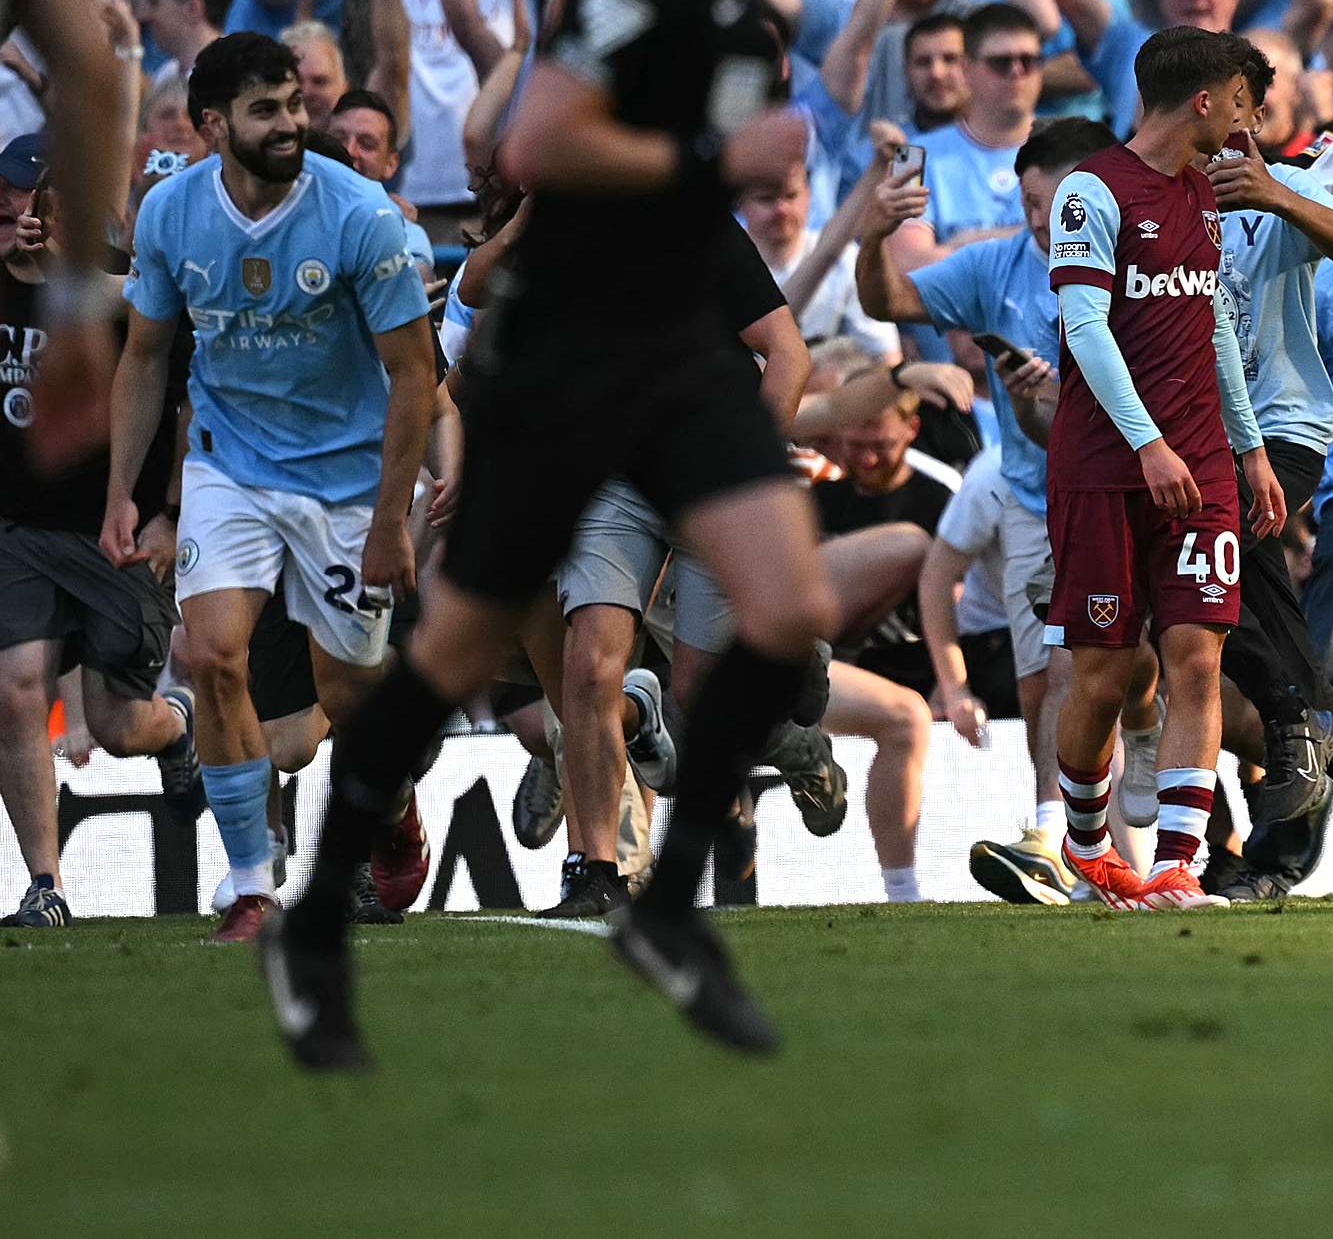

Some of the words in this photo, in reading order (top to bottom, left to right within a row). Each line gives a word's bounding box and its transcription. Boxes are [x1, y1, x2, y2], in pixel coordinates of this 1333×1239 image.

[1064, 243, 1086, 252] room
[1064, 250, 1090, 258] racism
[1125, 264, 1218, 305] betwa
[1177, 530, 1241, 586] 40
[1202, 596, 1224, 604] umbro
